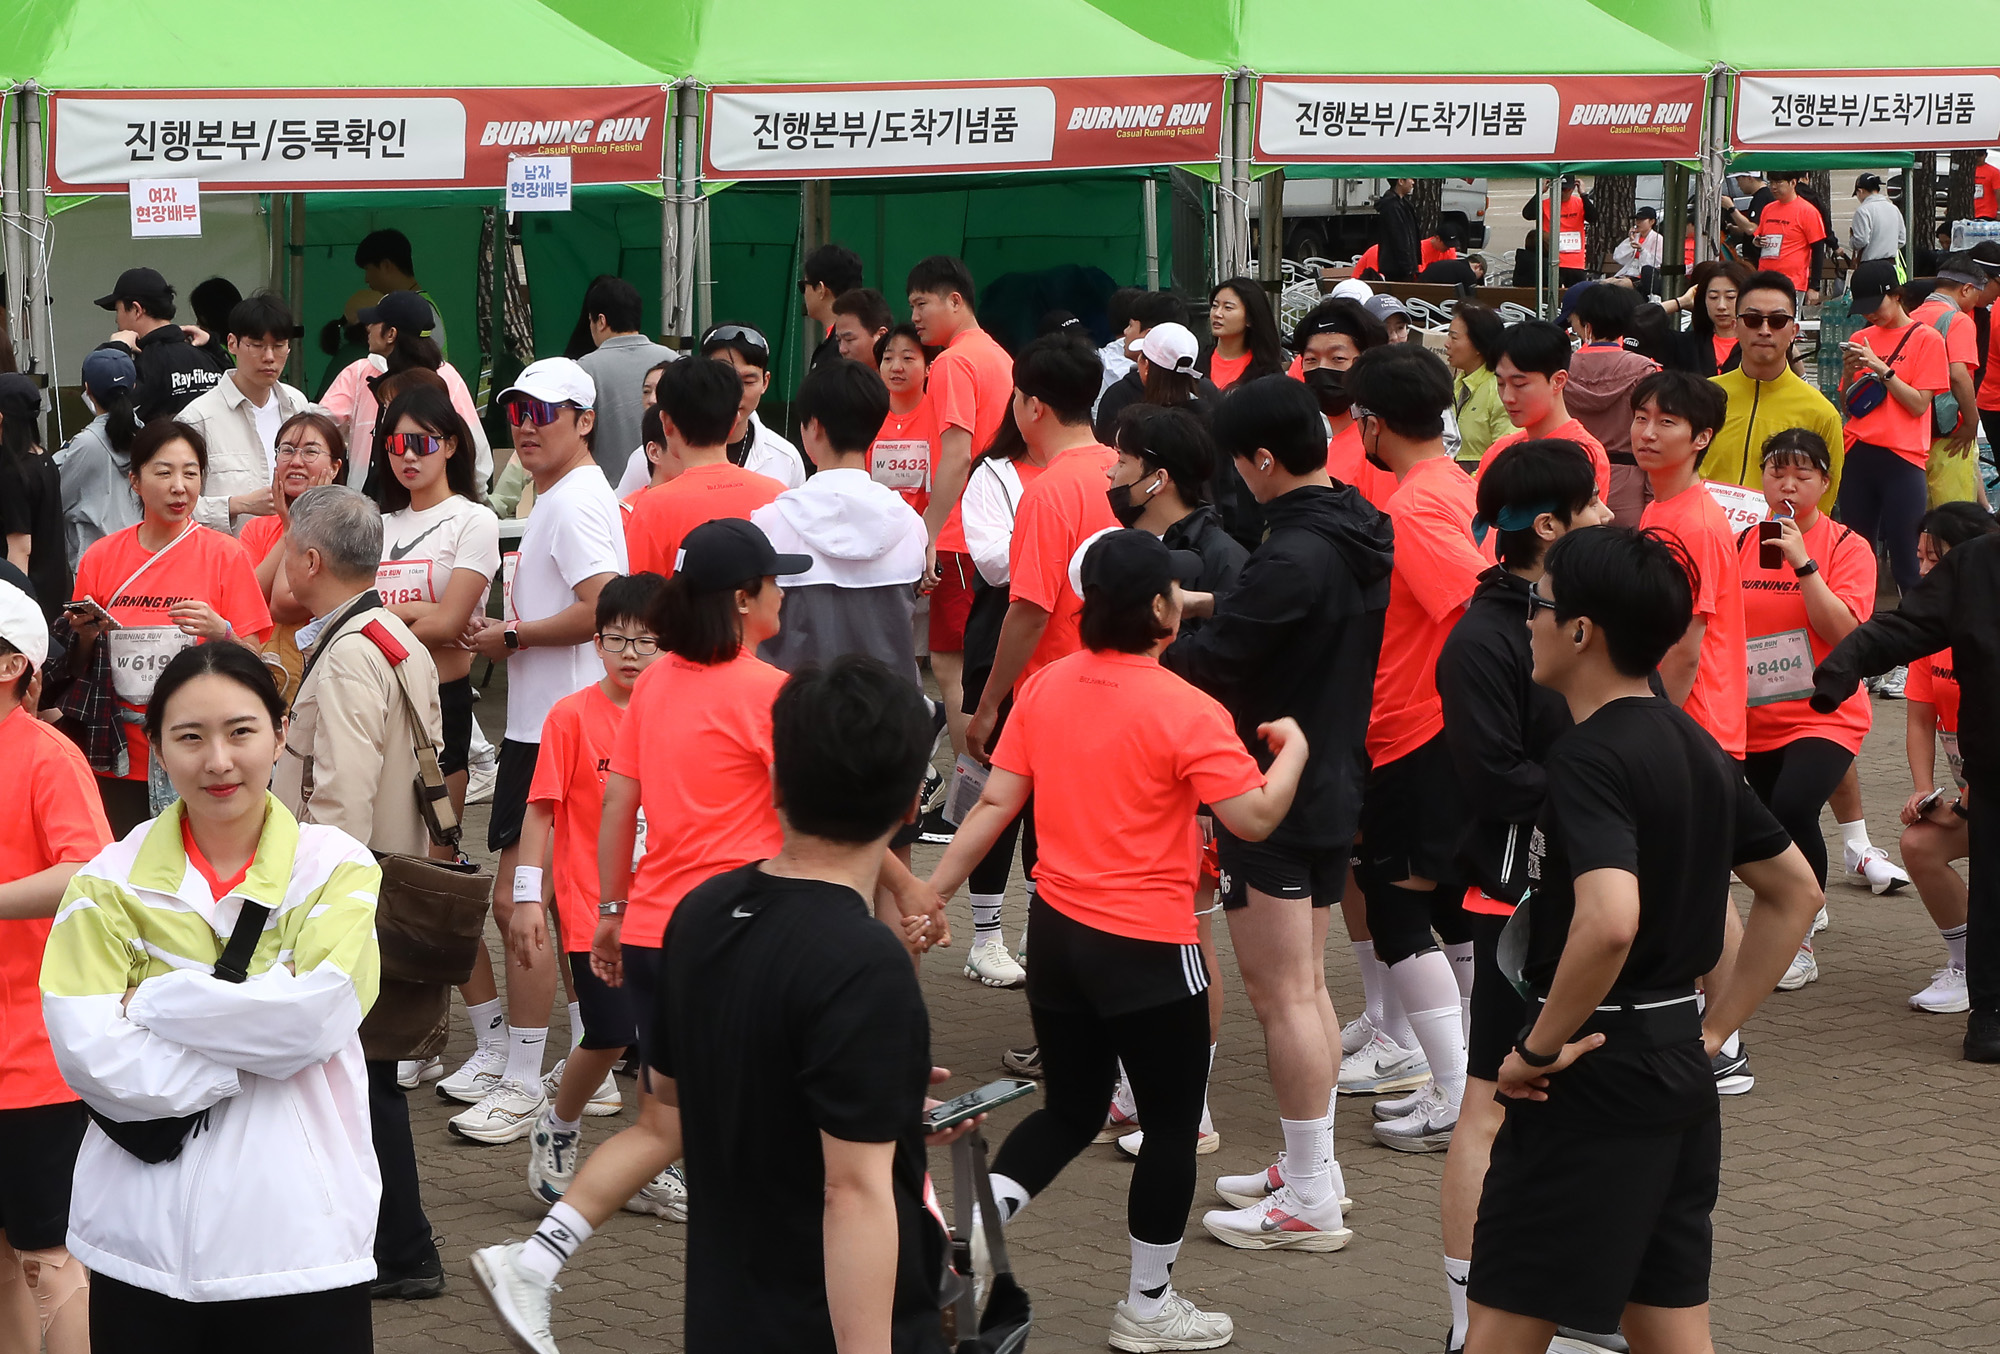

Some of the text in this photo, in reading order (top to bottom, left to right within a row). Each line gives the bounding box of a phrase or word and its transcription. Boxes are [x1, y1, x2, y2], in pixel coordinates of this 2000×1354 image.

[1066, 102, 1213, 131] BURNING RUN
[1295, 101, 1527, 138] 진행본부/도착기념품
[1568, 102, 1694, 126] BURNING RUN
[1771, 92, 1976, 128] 진행본부/도착기념품
[479, 117, 652, 147] BURNING RUN
[752, 106, 1019, 151] 진행본부/도착기념품
[1116, 126, 1205, 138] Casual Running Festival
[1609, 124, 1686, 135] Casual Running Festival
[124, 118, 407, 162] 진행본부/등록확인
[538, 142, 643, 155] Casual Running Festival
[524, 165, 552, 180] 남자
[148, 187, 178, 204] 여자
[511, 181, 569, 199] 현장배부
[135, 204, 198, 224] 현장배부
[888, 458, 928, 471] 3432
[1721, 505, 1759, 525] 156
[380, 588, 423, 606] 3183
[114, 633, 146, 641] BURNING
[146, 632, 163, 640] RUN
[117, 657, 130, 668] W
[1757, 654, 1803, 676] 8404
